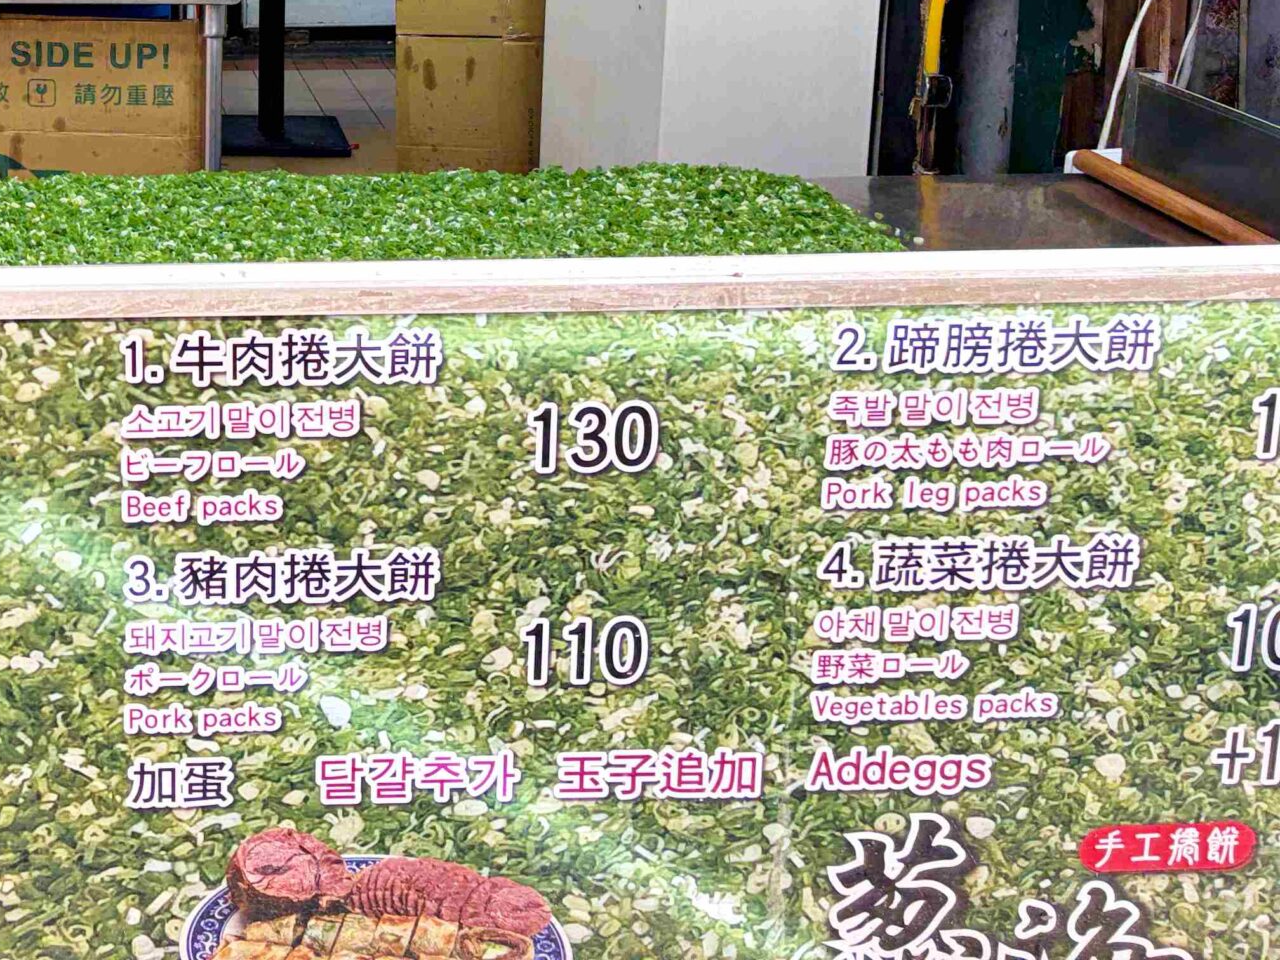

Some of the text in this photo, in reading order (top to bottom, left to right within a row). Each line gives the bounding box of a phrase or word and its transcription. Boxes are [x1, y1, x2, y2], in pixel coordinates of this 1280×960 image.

[10, 40, 95, 68] SIDE
[109, 42, 170, 69] UP!
[74, 83, 175, 107] 請勿重壓
[124, 333, 439, 383] 1.牛肉捲大餅
[835, 319, 1156, 368] 2.蹄膀捲大餅
[126, 405, 218, 435] 소고기
[297, 403, 359, 433] 전병
[832, 393, 891, 423] 족발
[973, 391, 1035, 420] 전병
[532, 405, 656, 470] 130
[829, 438, 1108, 466] 豚の太もも肉ロール
[126, 451, 300, 478] ビーフロール
[126, 494, 279, 520] Beef packs
[826, 480, 1042, 507] Pork leg packs
[128, 552, 437, 601] 3.豬肉捲大餅
[822, 539, 1136, 588] 4.蔬菜捲大餅
[326, 619, 384, 648] 전병
[819, 611, 875, 637] 야채
[956, 607, 1015, 636] 전병
[525, 621, 646, 683] 110
[816, 653, 965, 679] 野菜ロール
[128, 667, 302, 693] ポークロール
[128, 706, 278, 733] Pork packs
[815, 692, 1054, 720] Vegetables packs
[132, 761, 232, 806] 加蛋
[558, 751, 765, 797] 玉子追加
[810, 749, 990, 791] Addeggs
